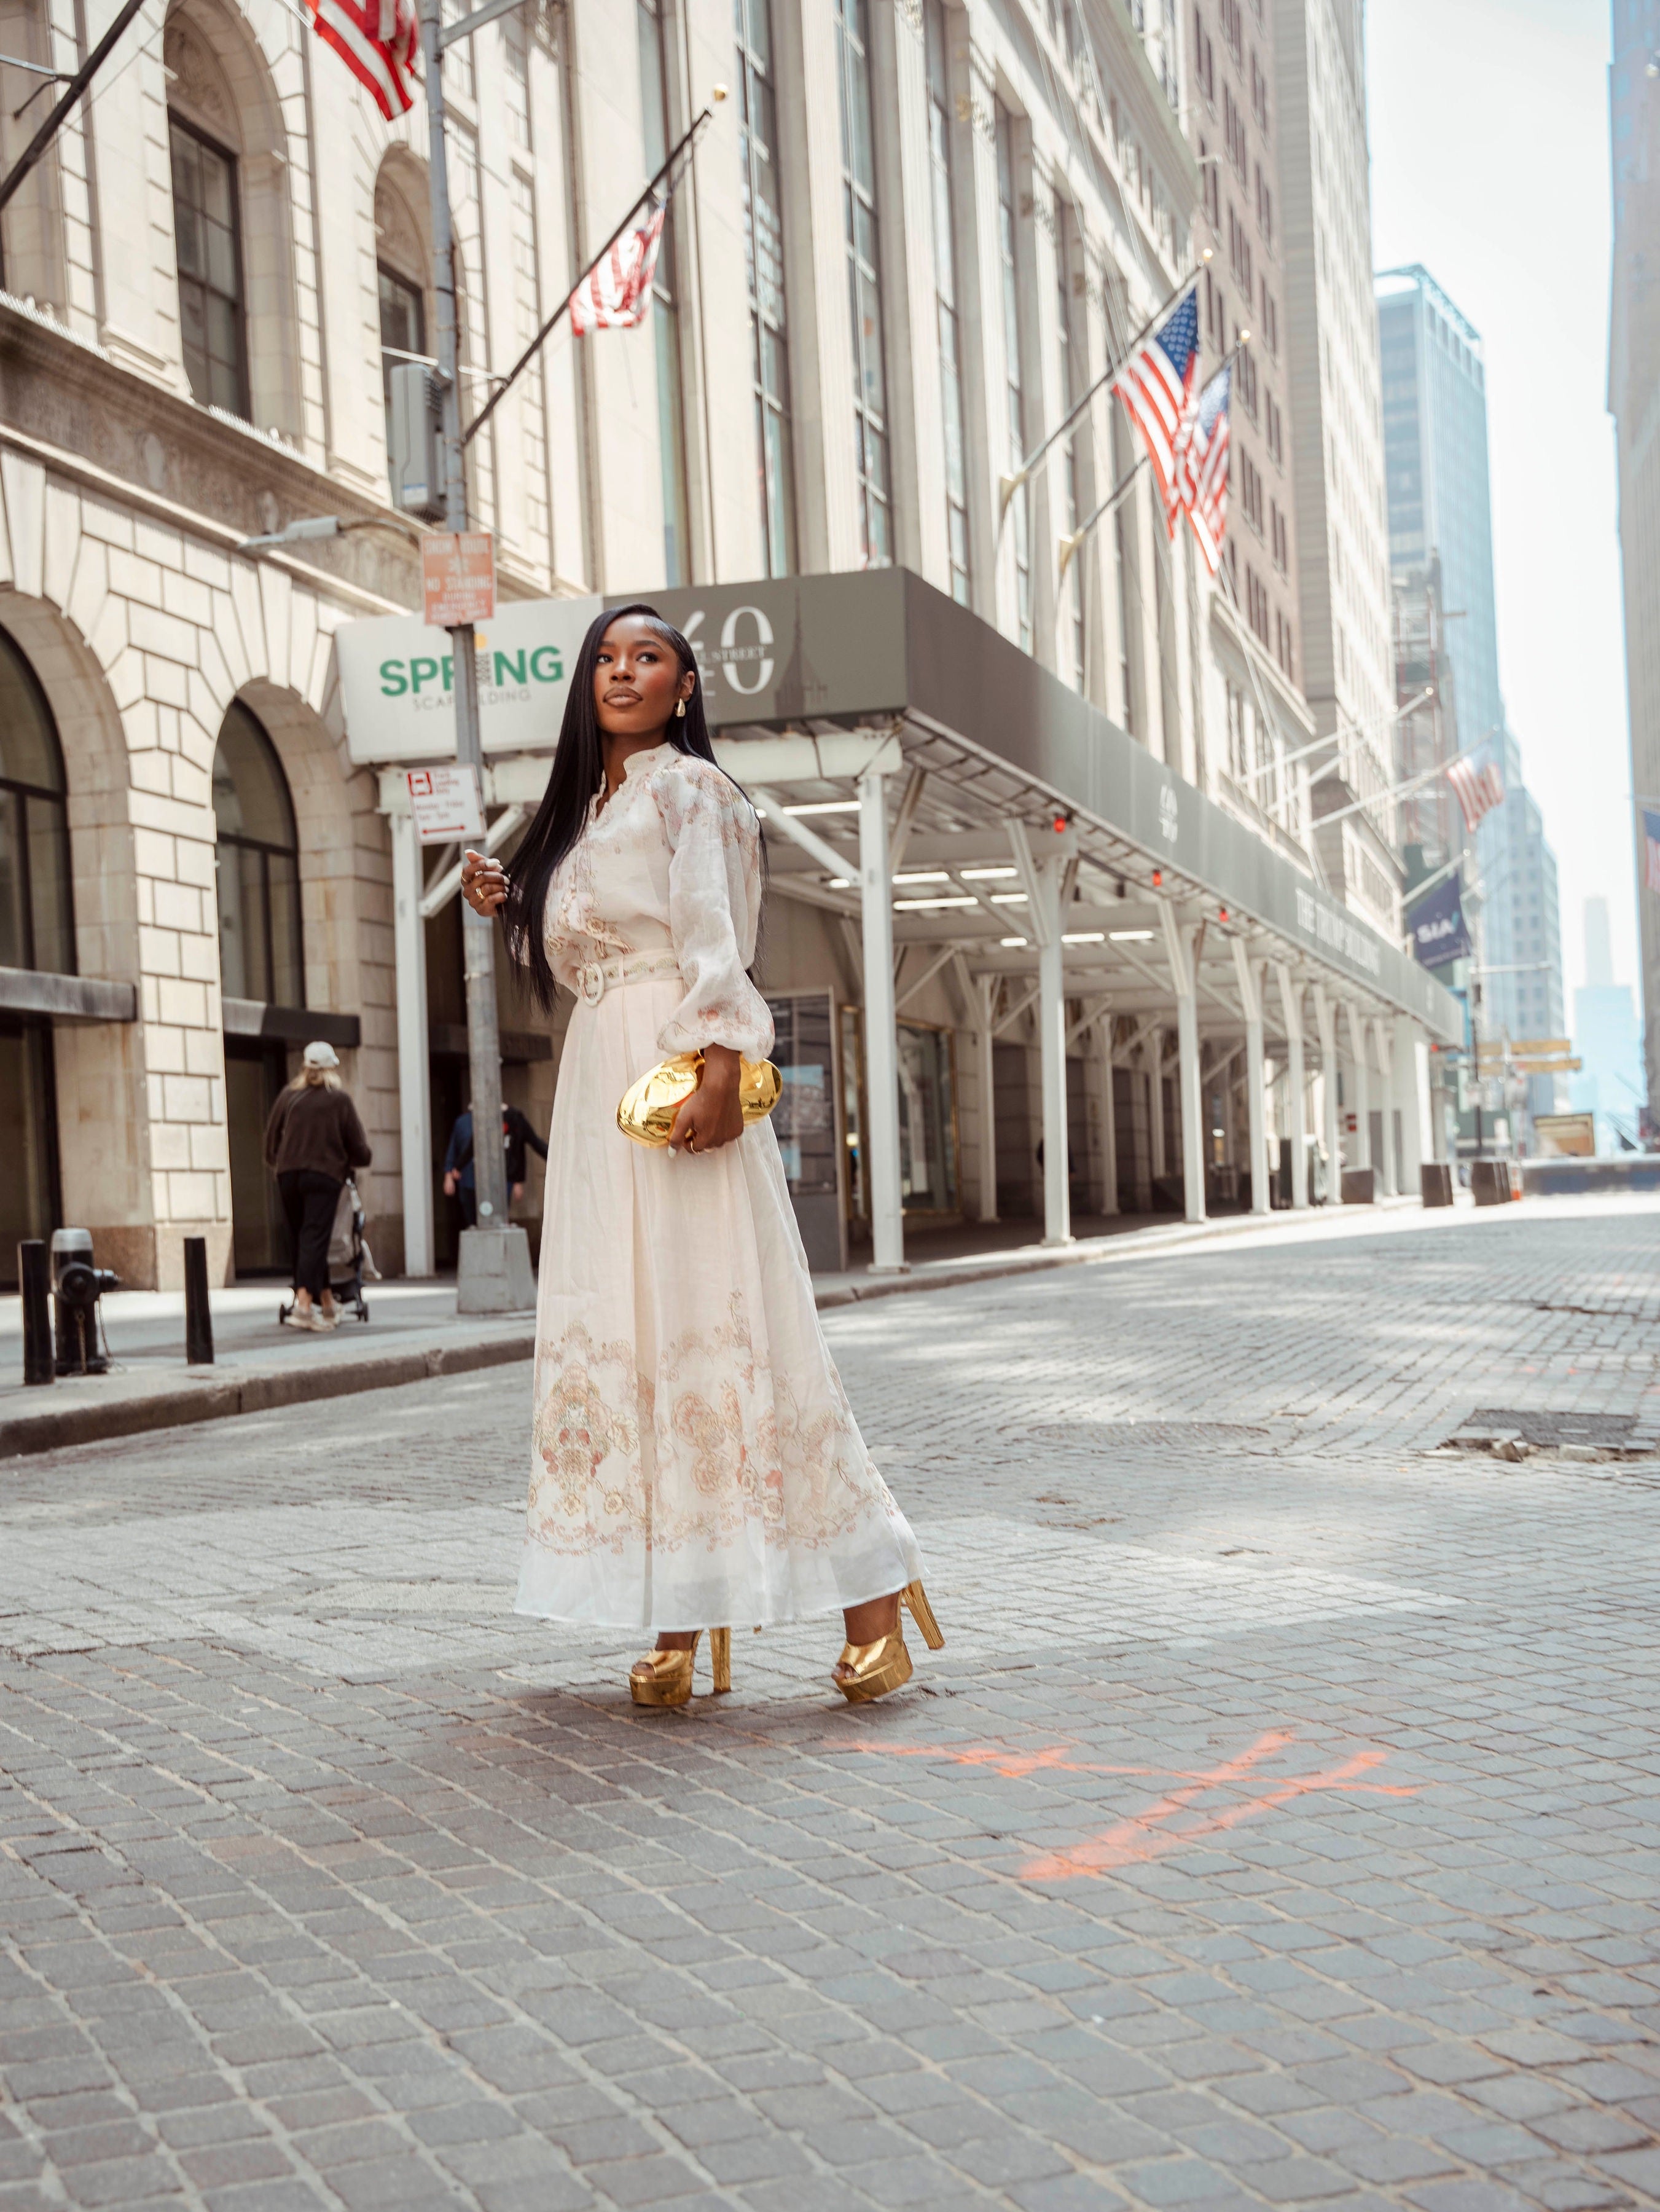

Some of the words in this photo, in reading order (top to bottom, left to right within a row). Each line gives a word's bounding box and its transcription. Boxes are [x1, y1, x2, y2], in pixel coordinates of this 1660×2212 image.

[426, 577, 440, 592] NO
[445, 575, 492, 591] STANDING
[412, 689, 532, 711] SCAFLDING
